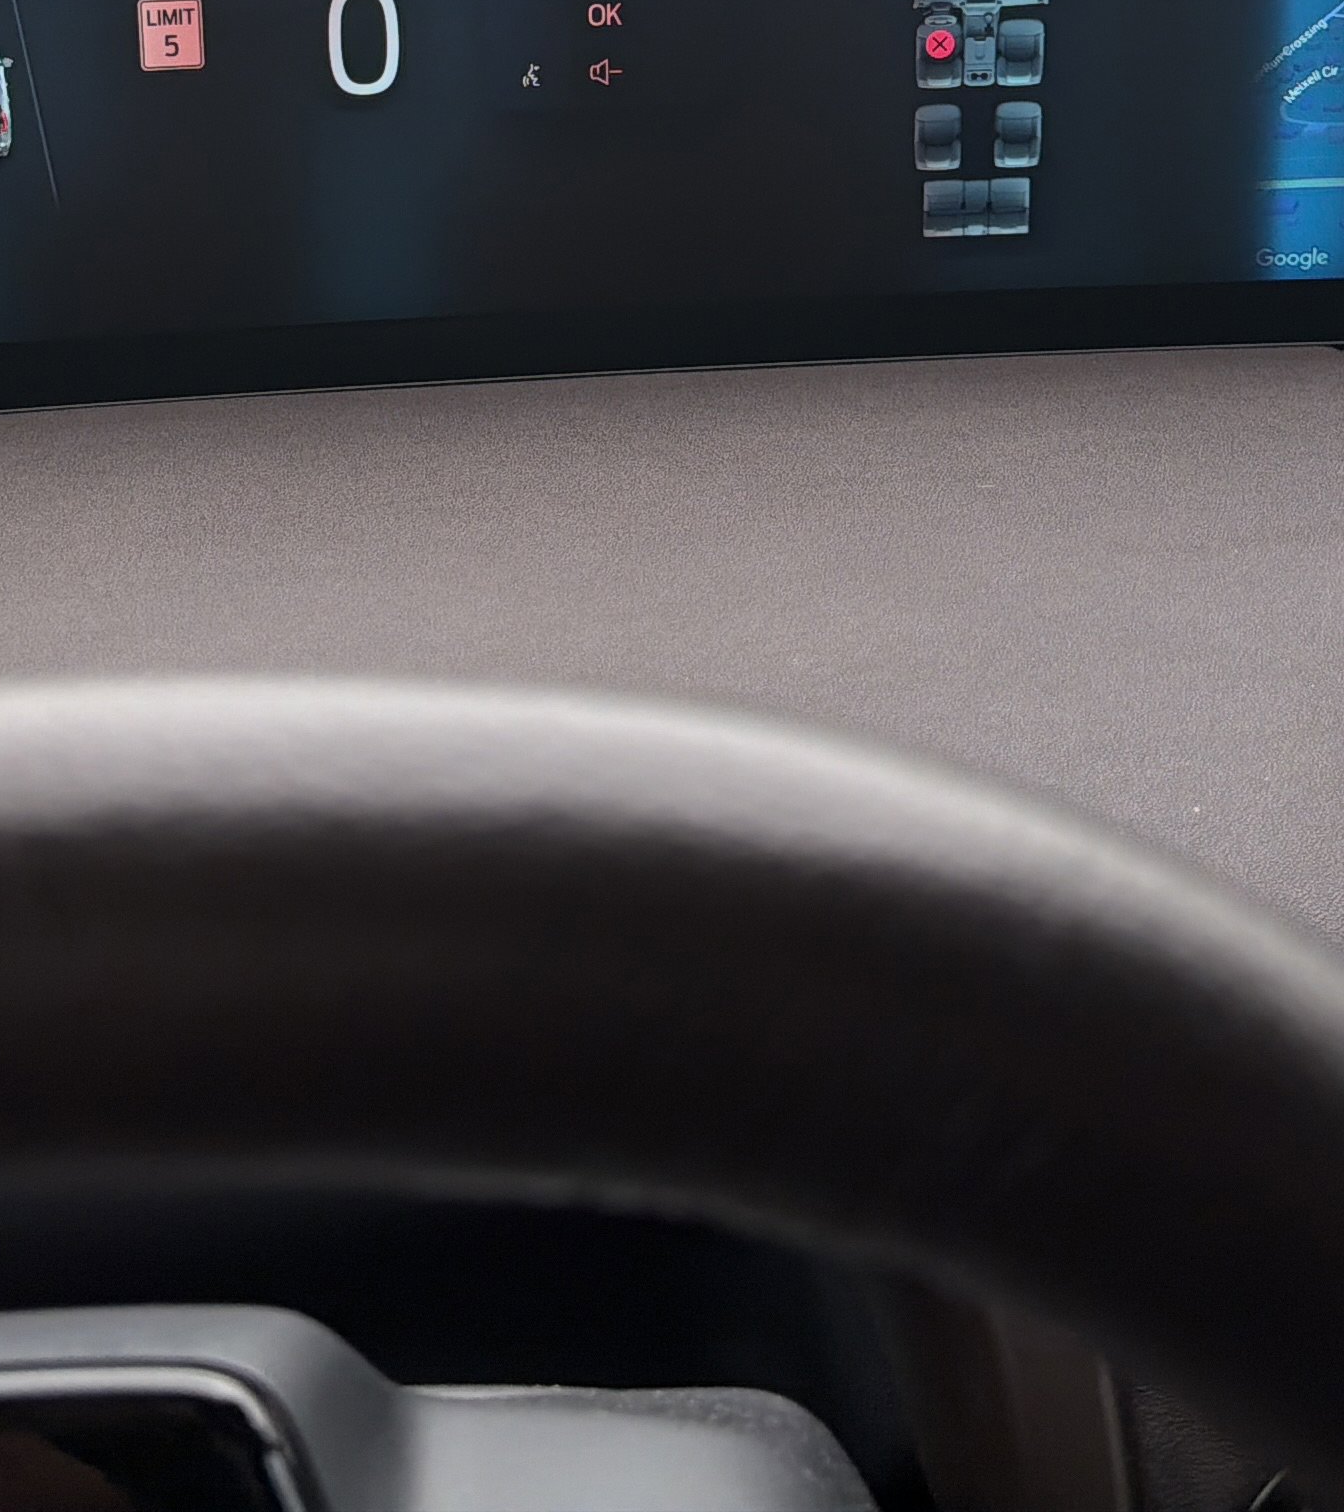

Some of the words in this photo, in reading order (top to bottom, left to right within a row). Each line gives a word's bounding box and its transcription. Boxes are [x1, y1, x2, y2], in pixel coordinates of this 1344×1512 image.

[145, 7, 196, 27] LIMIT
[587, 2, 623, 27] OK
[163, 34, 180, 59] 5
[1262, 52, 1284, 73] Run
[1282, 19, 1328, 56] Crossing
[1256, 247, 1329, 271] Google
